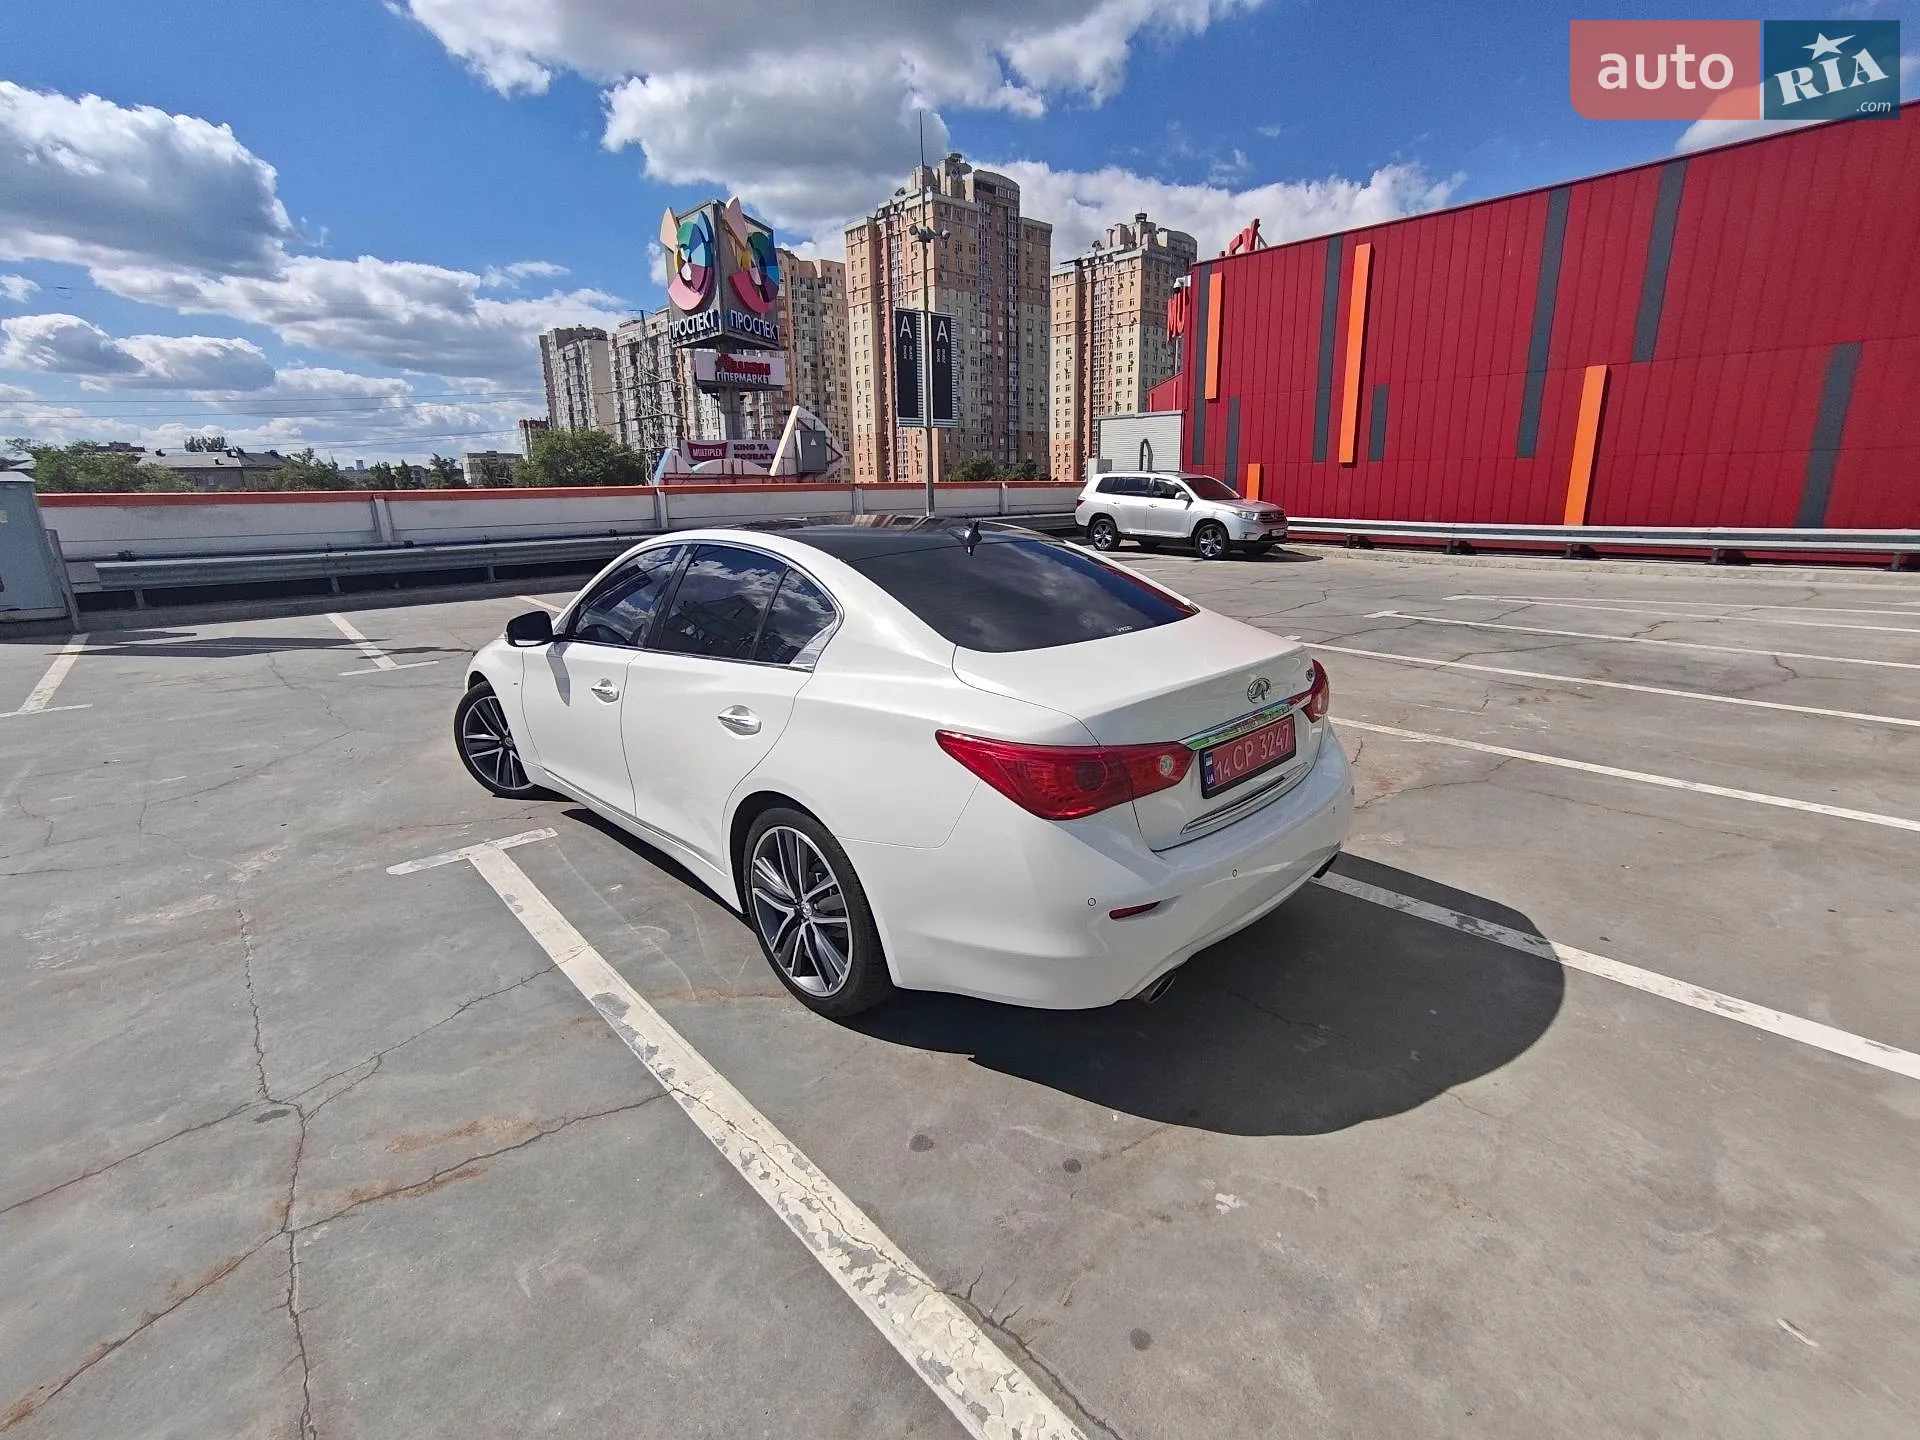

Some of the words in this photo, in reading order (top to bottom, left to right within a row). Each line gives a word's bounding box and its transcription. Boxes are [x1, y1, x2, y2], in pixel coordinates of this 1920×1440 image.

[668, 308, 715, 340] ПРОСПЕКТ
[730, 309, 780, 342] ПРОСПЕКТ
[692, 448, 723, 457] MULTIPLEX
[1216, 758, 1231, 781] 14
[1233, 741, 1254, 770] CP
[1259, 723, 1290, 760] 3247
[1206, 774, 1215, 785] UA
